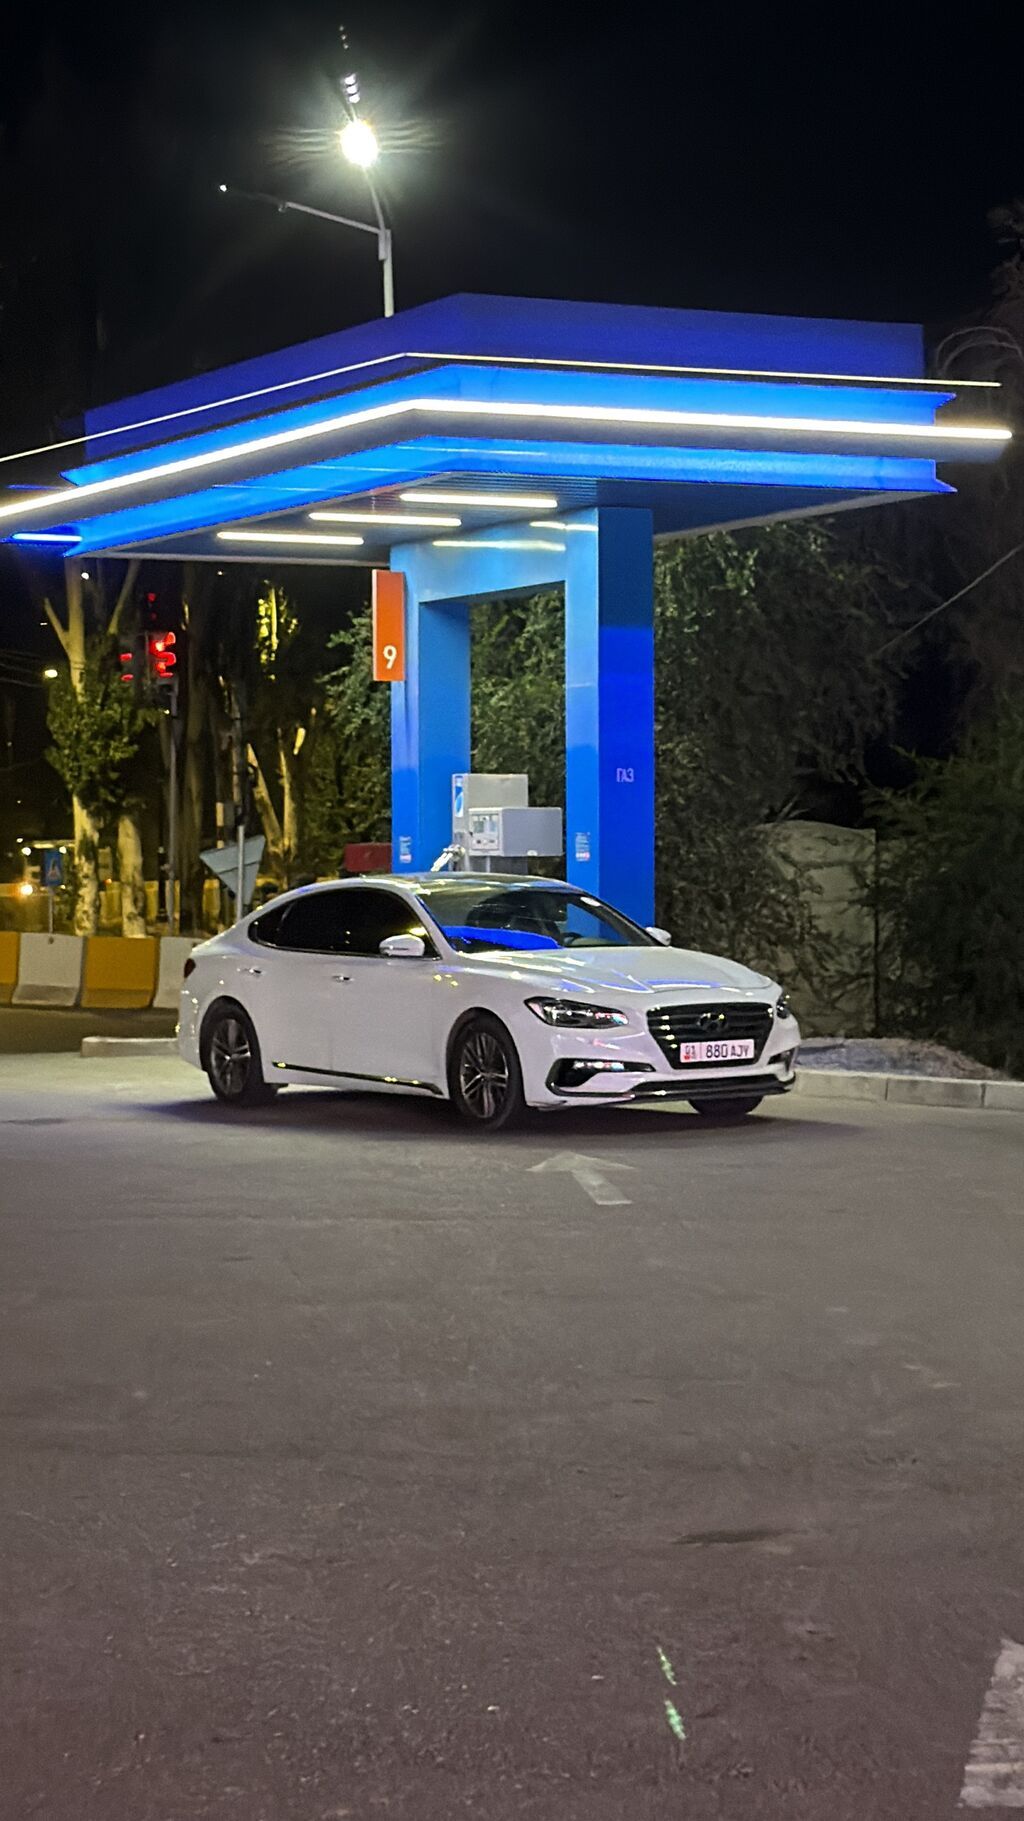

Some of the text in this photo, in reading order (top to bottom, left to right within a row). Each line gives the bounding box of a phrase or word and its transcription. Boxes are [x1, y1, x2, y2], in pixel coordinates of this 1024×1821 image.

[383, 645, 397, 669] 9
[616, 767, 635, 783] ГАЗ
[706, 1044, 728, 1058] 880
